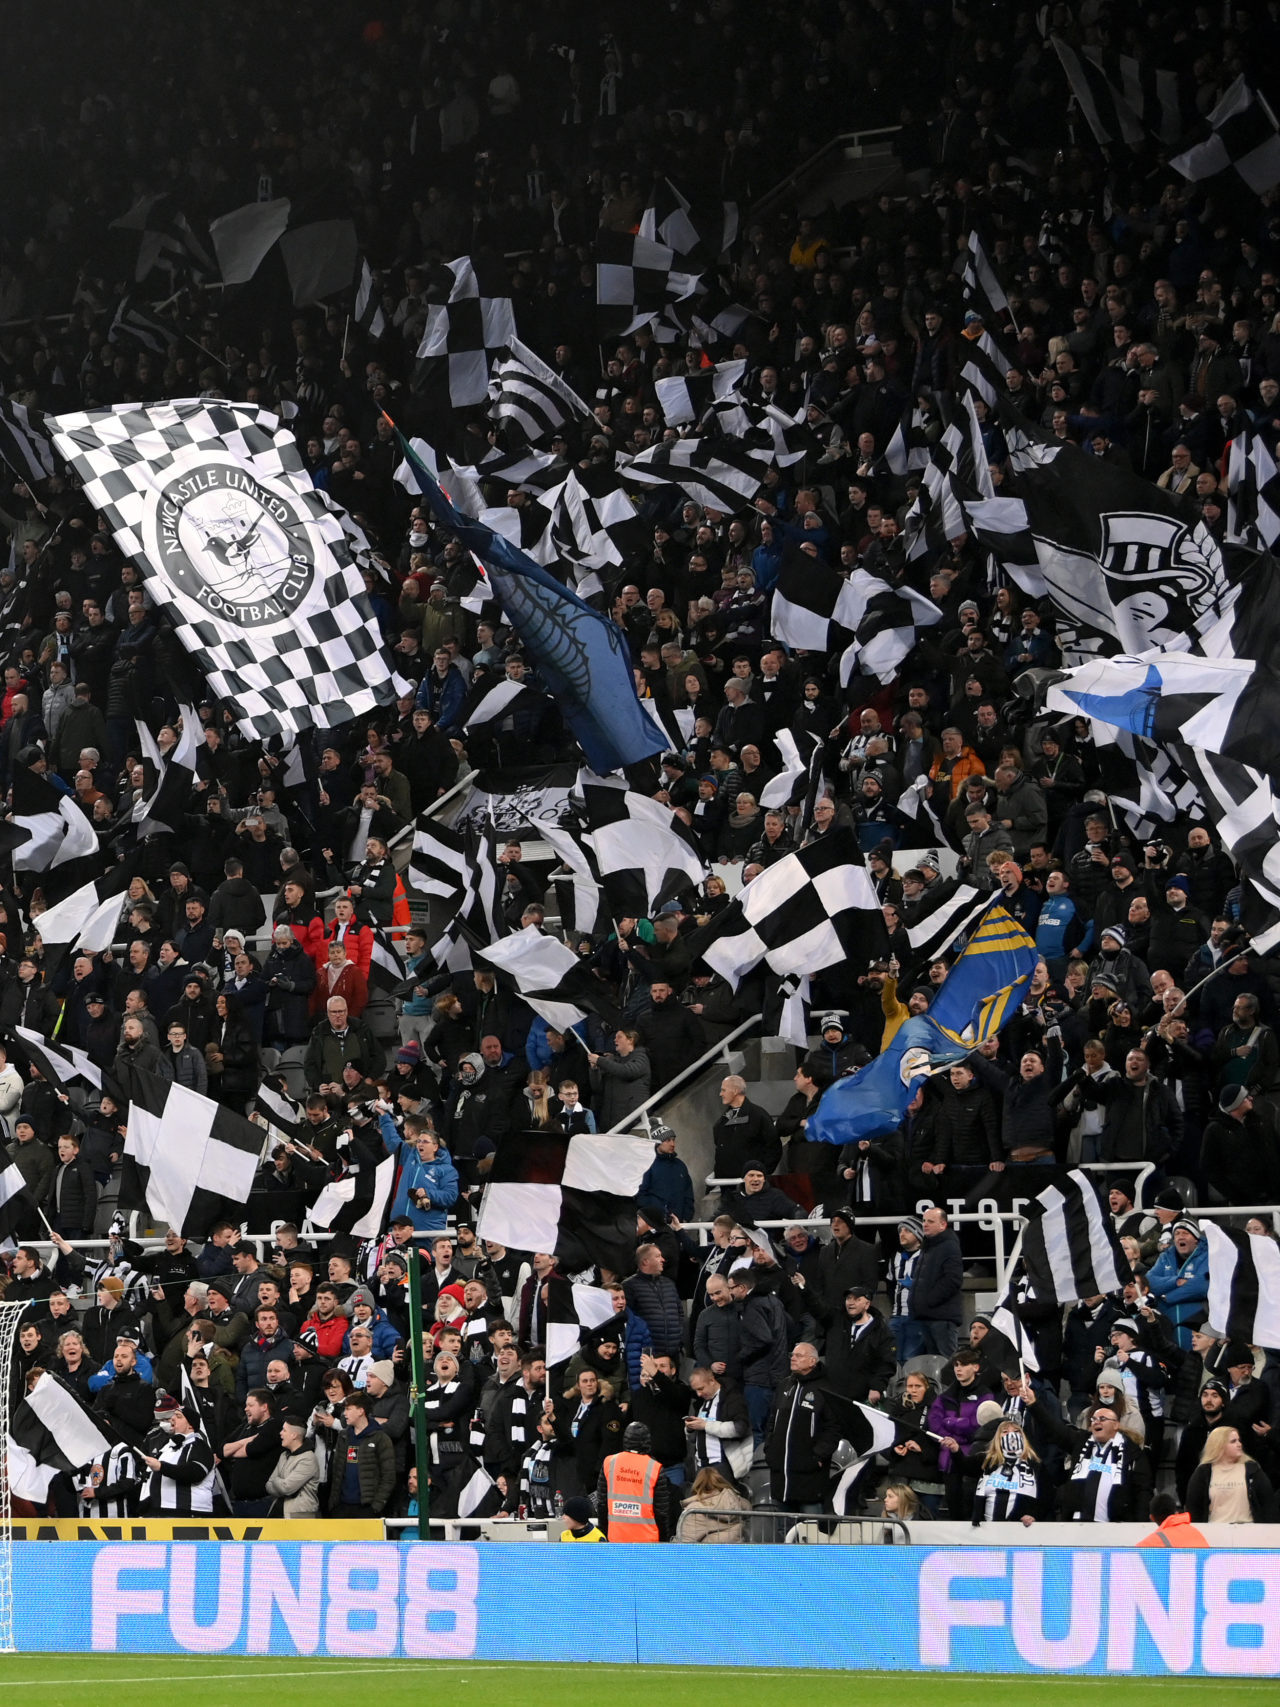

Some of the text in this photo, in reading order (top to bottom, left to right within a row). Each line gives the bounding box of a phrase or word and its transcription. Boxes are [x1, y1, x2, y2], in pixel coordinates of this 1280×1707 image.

[163, 470, 288, 555] NEWCASTLE UNITED
[195, 553, 308, 622] FOOTBAL CLUB
[616, 1475, 642, 1484] Steward
[620, 1466, 640, 1476] Safety
[91, 1544, 480, 1656] FUN88
